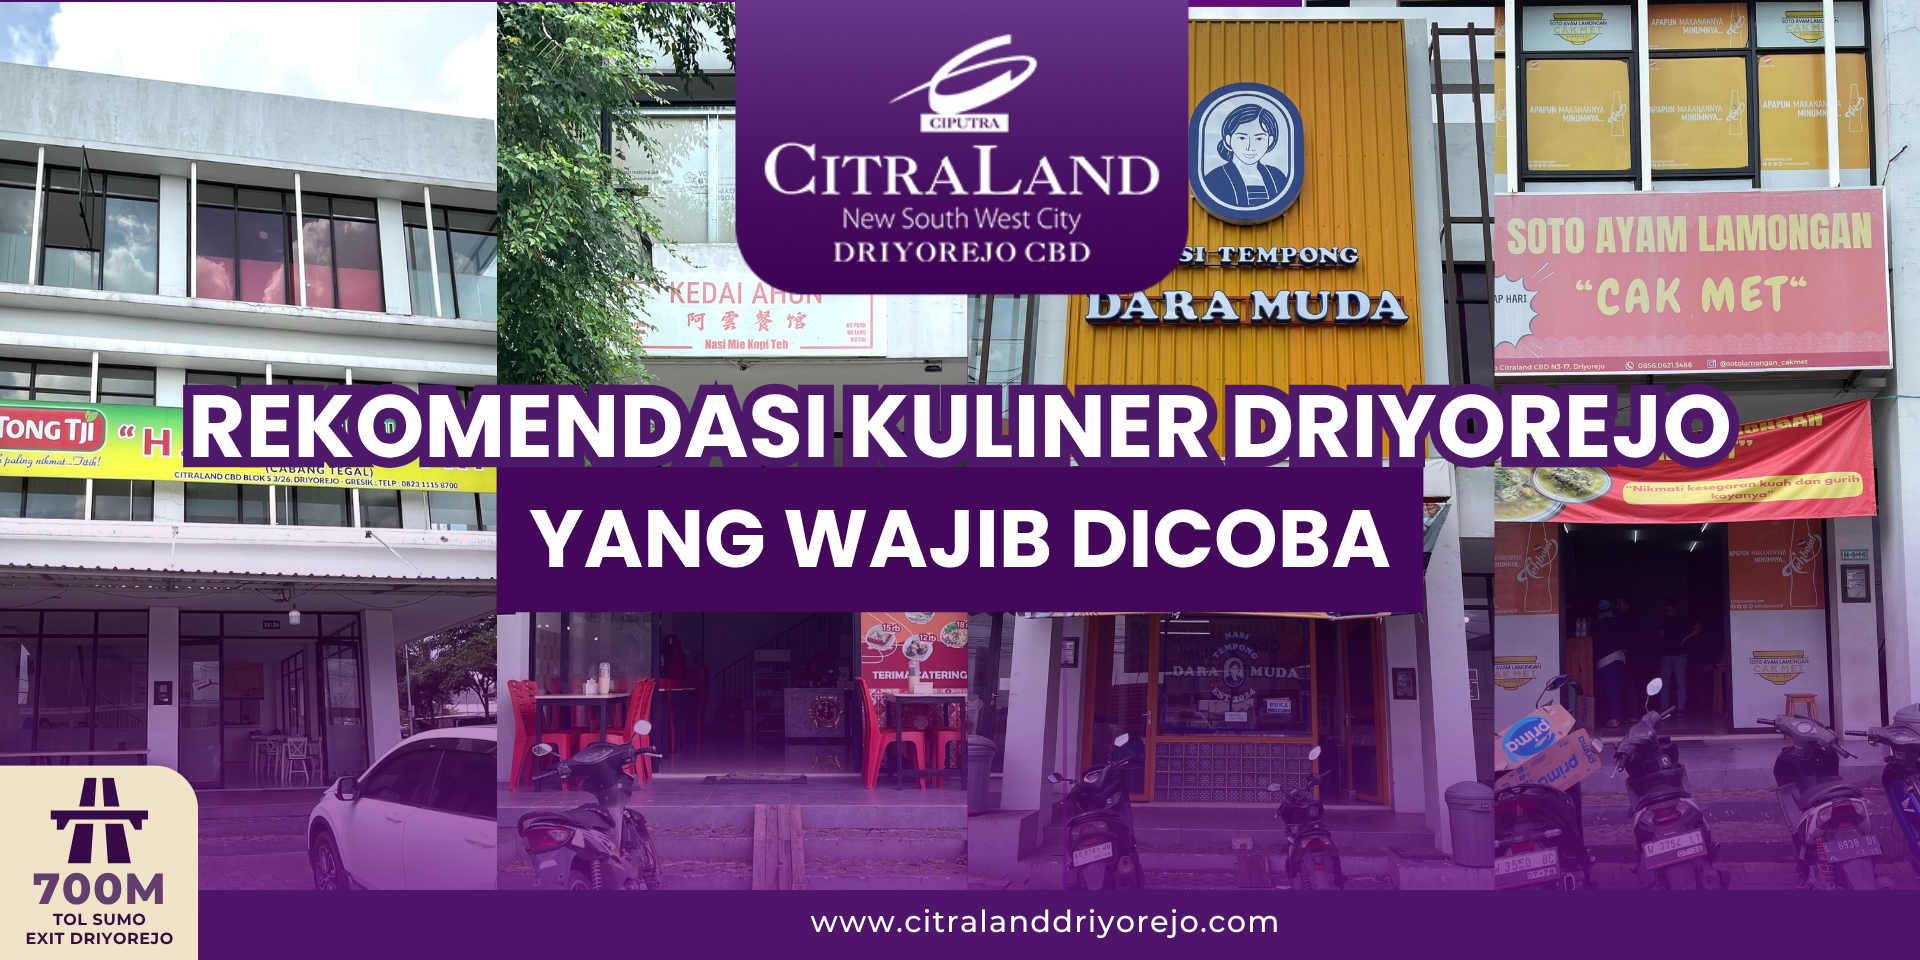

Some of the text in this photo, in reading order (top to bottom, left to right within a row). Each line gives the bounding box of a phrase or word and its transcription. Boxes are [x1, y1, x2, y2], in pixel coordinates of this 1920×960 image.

[1651, 17, 1723, 26] APAPUN MAKANANNYA
[1529, 106, 1605, 114] APAPUN MAKANANNYA
[1650, 105, 1723, 113] APAPUN MAKANANNYA
[1763, 100, 1842, 109] APAPUN MAKANANA
[1507, 212, 1873, 255] SOTO AYAM LAMONGAN
[1217, 246, 1359, 267] TEMPONG
[670, 281, 742, 304] KEDAI
[1506, 294, 1527, 303] HARI
[1085, 289, 1410, 324] DARA MUDA
[705, 338, 789, 351] Nasi Mie Kopi Teh
[1500, 363, 1532, 371] Citraland
[1573, 362, 1605, 371] Driyorejo
[1720, 358, 1809, 368] @sotolamongan_cakmet
[0, 415, 61, 441] TONG
[4, 454, 34, 468] paling
[330, 467, 374, 477] TEGAL)
[174, 471, 223, 480] CITRALAND
[224, 473, 242, 481] CBD
[243, 474, 265, 482] BLOK
[293, 476, 340, 485] DRIYOREJO
[345, 478, 373, 486] GRESIK
[379, 479, 397, 487] TELP
[402, 480, 420, 488] 0823
[1687, 481, 1758, 493] kesegaran
[1760, 478, 1792, 488] kuah
[1797, 476, 1821, 486] dan
[1824, 475, 1860, 486] gurih
[1225, 631, 1250, 640] NASI
[1212, 643, 1258, 660] TEMPONG
[1172, 665, 1299, 678] DARA MUDA
[1495, 670, 1537, 678] AK MET
[1753, 664, 1805, 673] CAK MET
[872, 671, 909, 680] TERIMA
[1211, 686, 1256, 703] EST 2024
[1505, 718, 1551, 753] prima
[1578, 735, 1597, 765] prima
[1837, 838, 1860, 850] 6938
